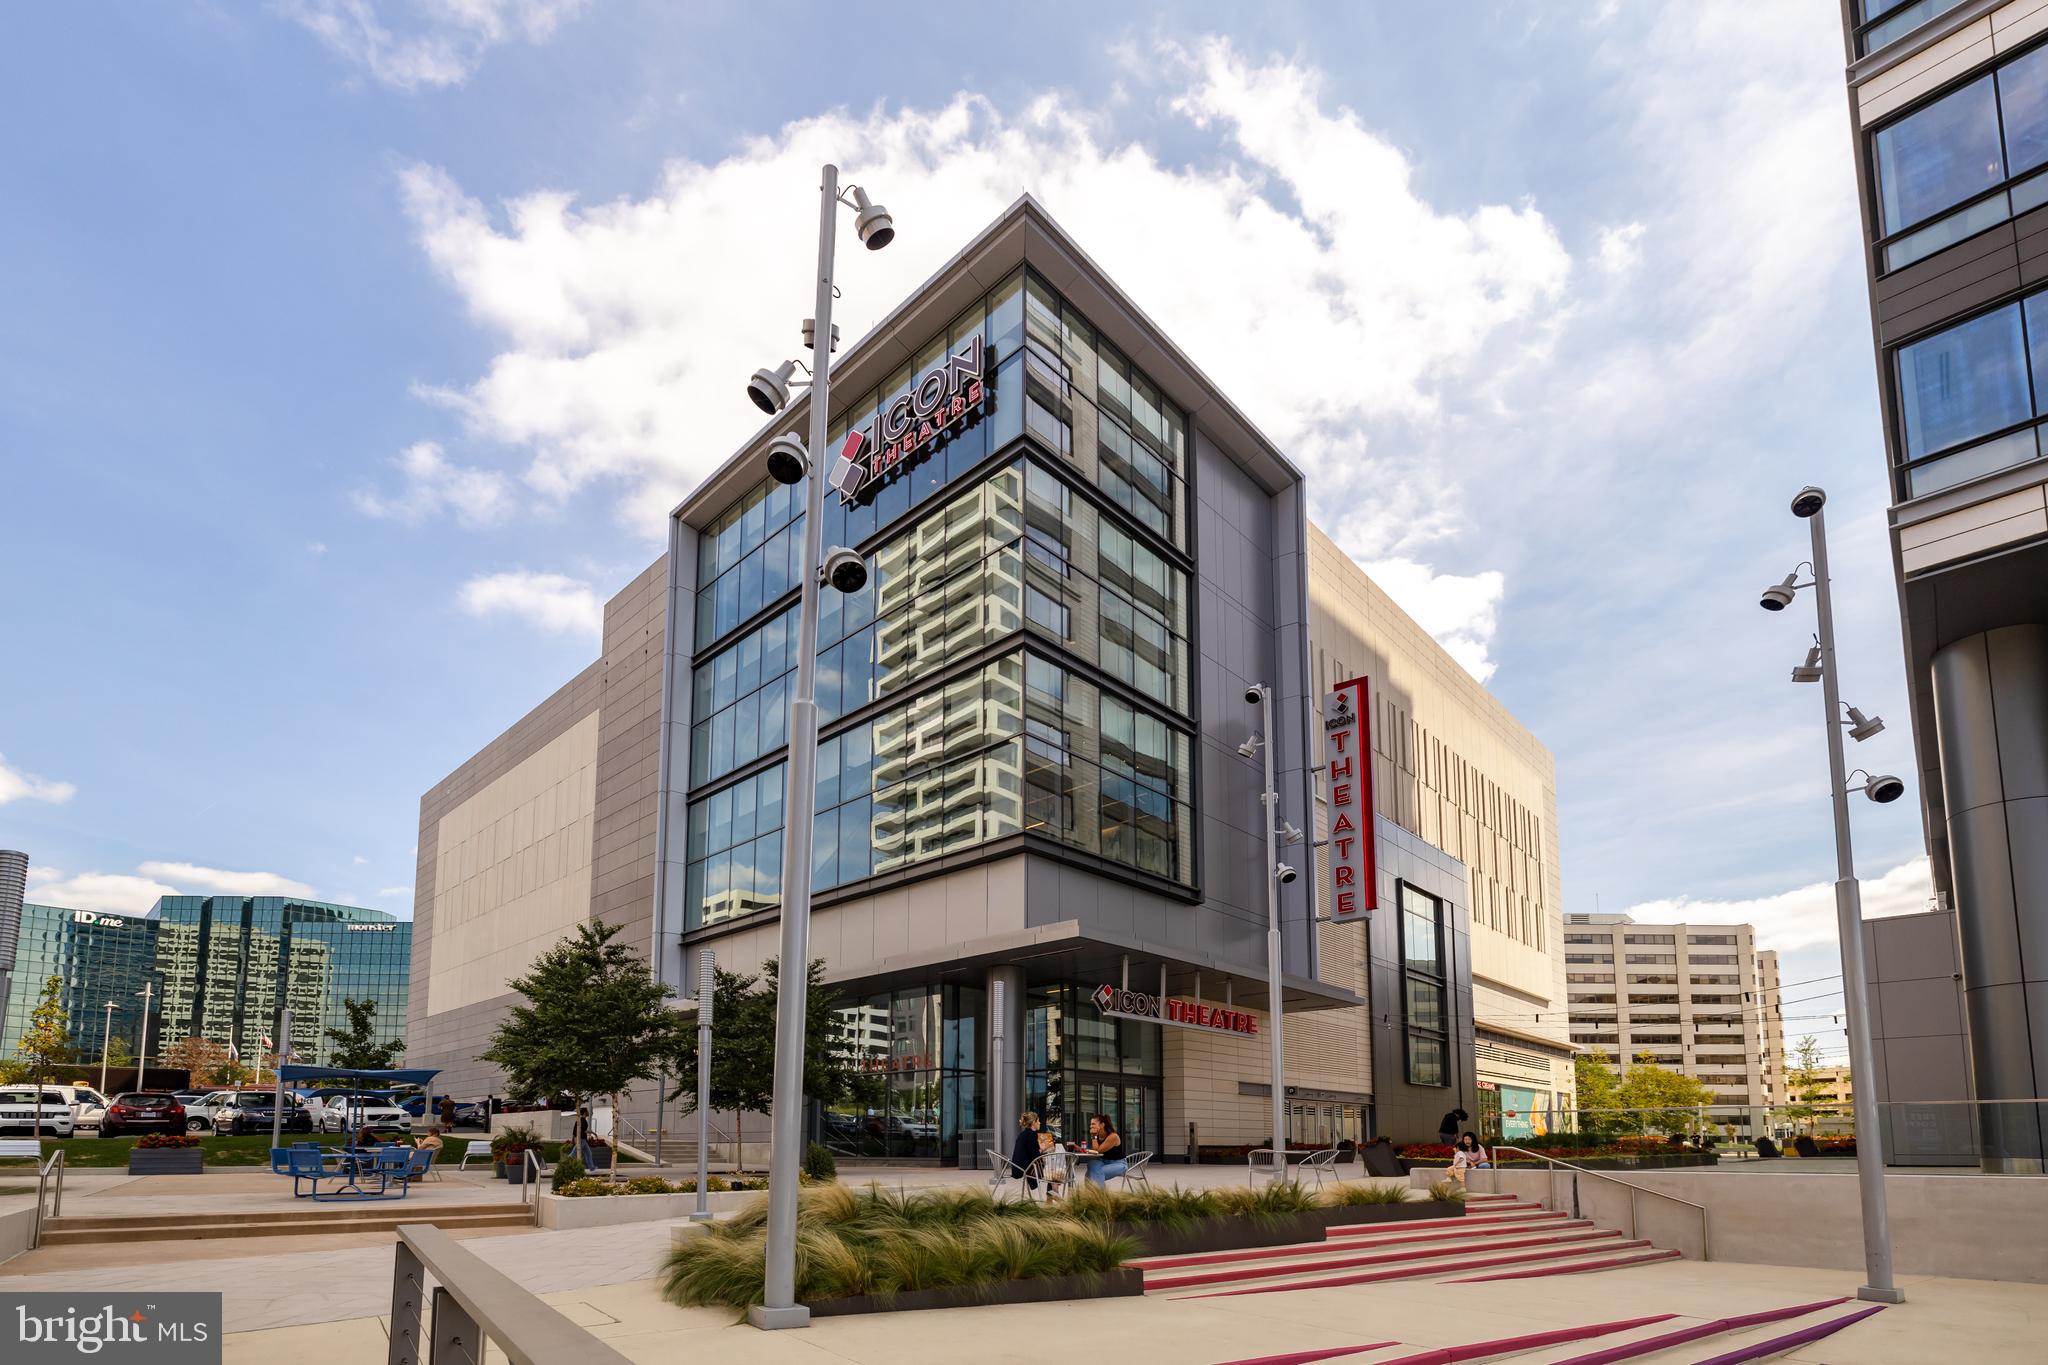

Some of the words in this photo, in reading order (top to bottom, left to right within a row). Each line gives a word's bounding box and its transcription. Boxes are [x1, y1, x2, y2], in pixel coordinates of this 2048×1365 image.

[871, 334, 982, 452] ICON
[872, 381, 983, 474] THEATRE
[1325, 713, 1355, 730] ICON
[1330, 730, 1356, 914] THEATRE
[74, 910, 124, 927] ID.me
[347, 923, 396, 931] monster
[1114, 988, 1161, 1018] ICON
[1167, 999, 1258, 1034] THEATRE
